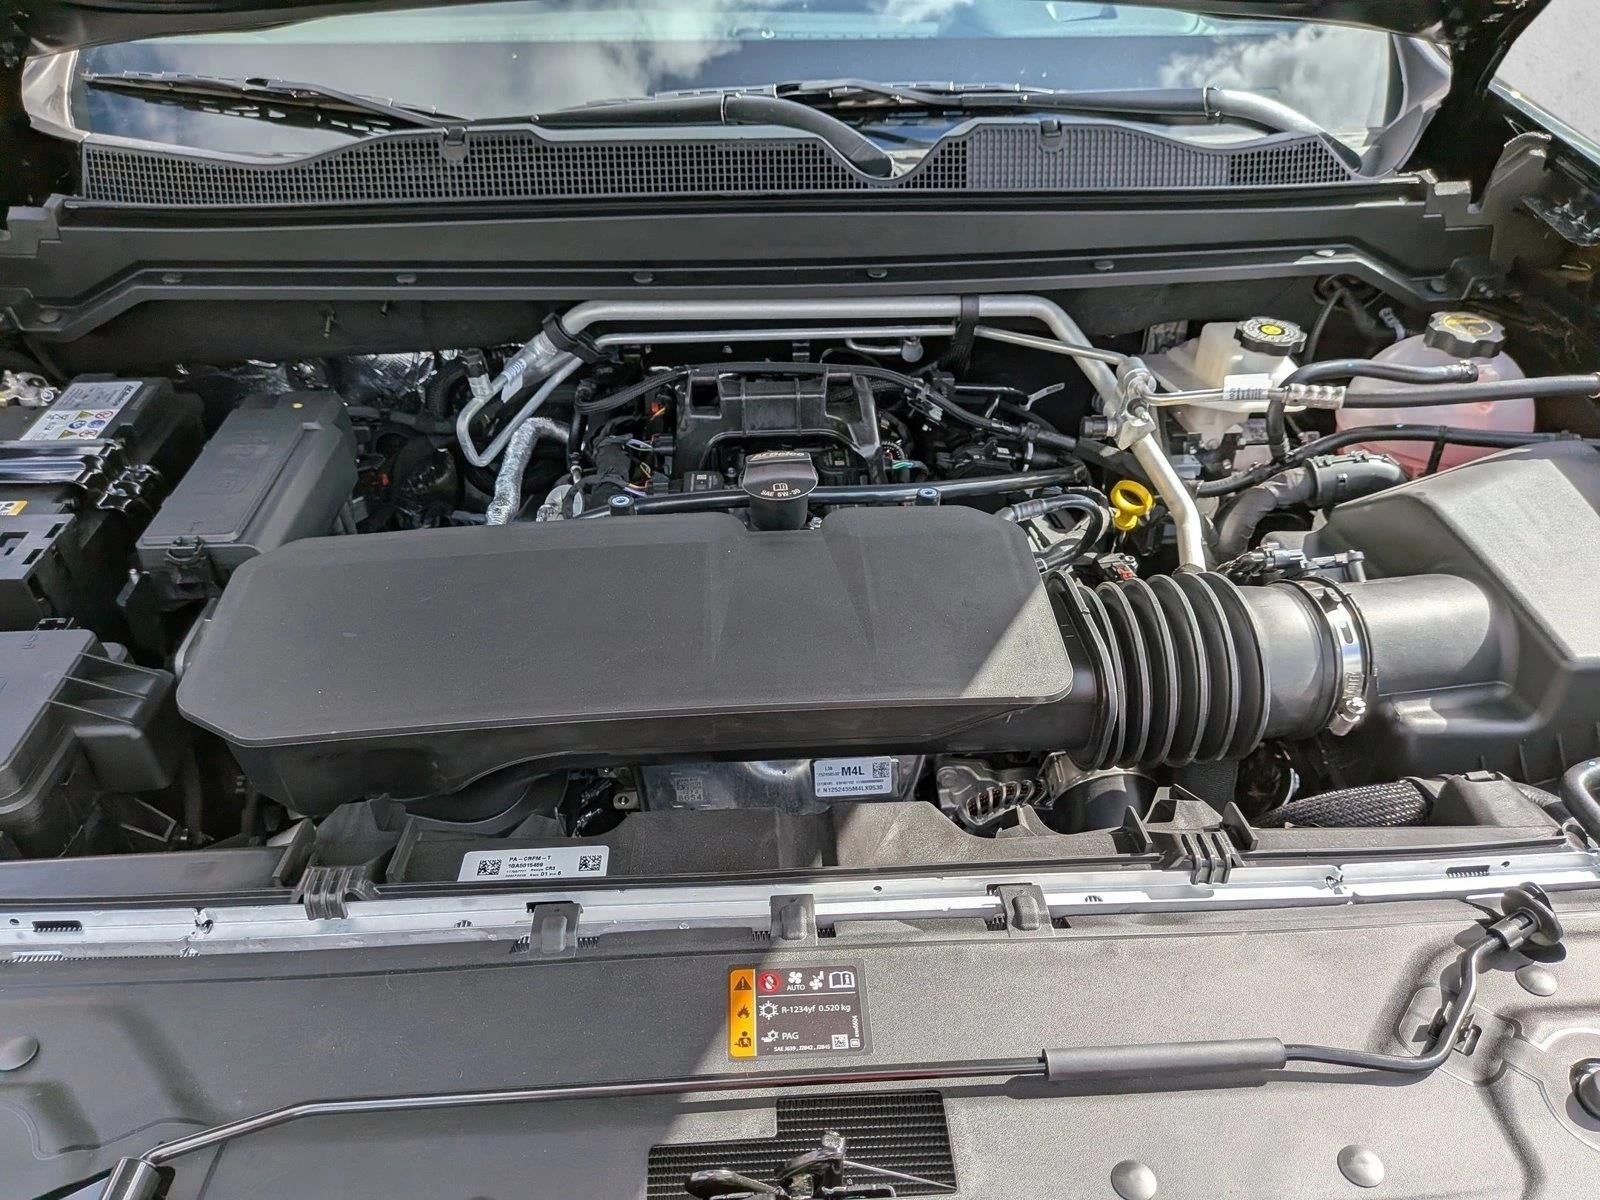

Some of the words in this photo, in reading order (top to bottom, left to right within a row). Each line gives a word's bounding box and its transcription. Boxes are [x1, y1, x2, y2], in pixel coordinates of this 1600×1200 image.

[760, 489, 774, 497] SAE
[841, 766, 865, 776] M4L
[781, 1004, 816, 1014] R-1234yf
[818, 1004, 840, 1012] 0.520
[841, 1003, 851, 1012] kg
[781, 1032, 799, 1040] PAG
